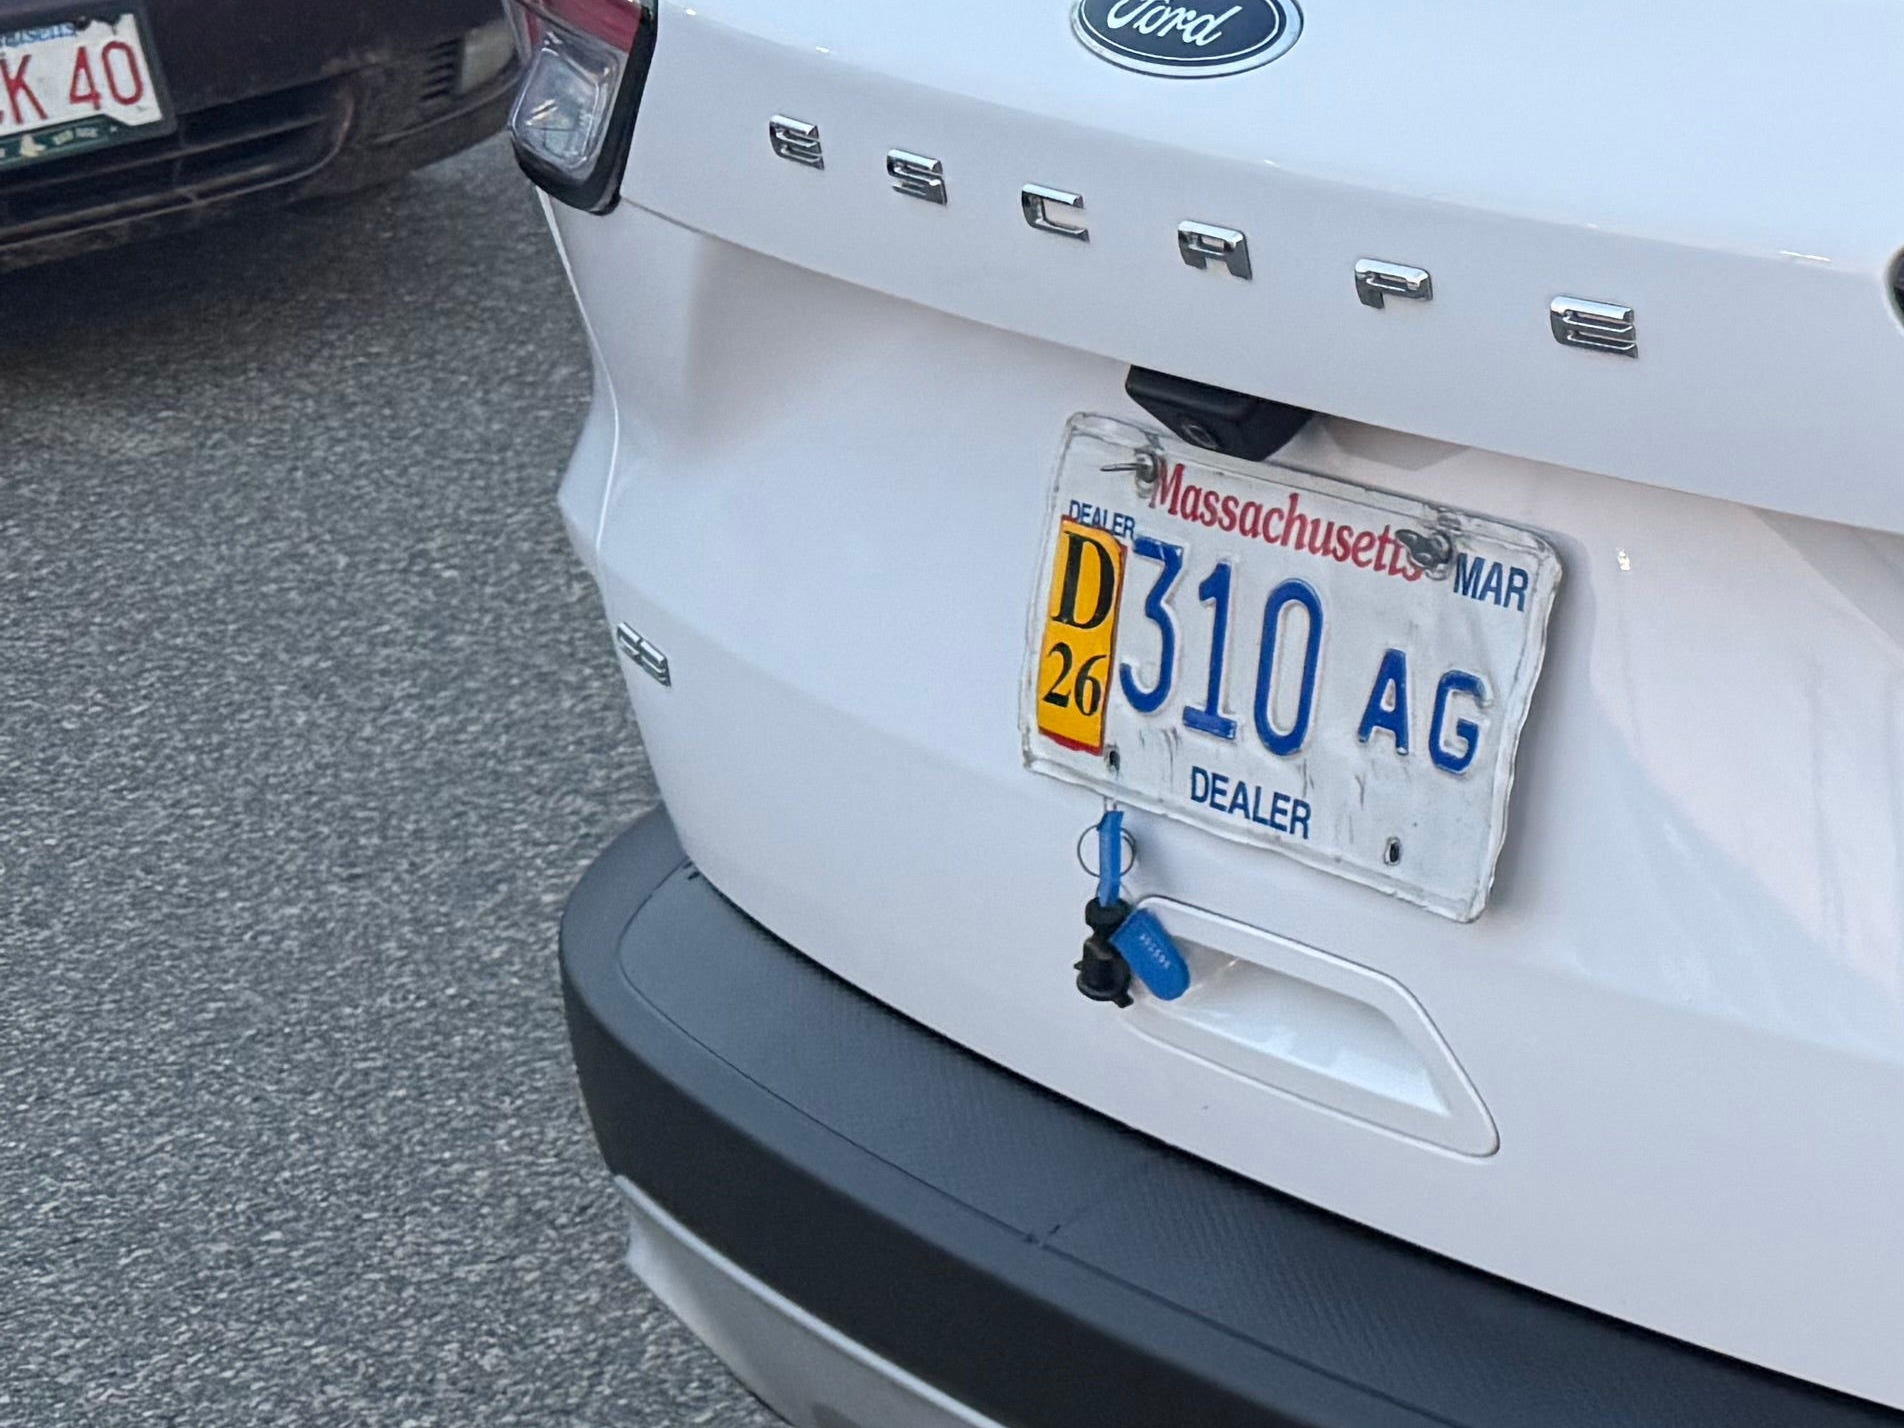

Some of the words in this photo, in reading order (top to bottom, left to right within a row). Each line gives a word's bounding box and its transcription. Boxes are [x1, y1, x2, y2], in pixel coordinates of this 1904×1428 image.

[0, 54, 48, 125] K
[69, 40, 143, 110] 40
[769, 113, 1639, 359] ESCAPE
[1069, 499, 1135, 540] DEALER
[1149, 463, 1424, 582] Massachusetts
[1051, 531, 1117, 631] D
[1453, 552, 1528, 612] MAR
[1042, 642, 1106, 718] 26
[1119, 535, 1325, 757] 310
[1357, 648, 1492, 774] AG
[1190, 766, 1313, 840] DEALER
